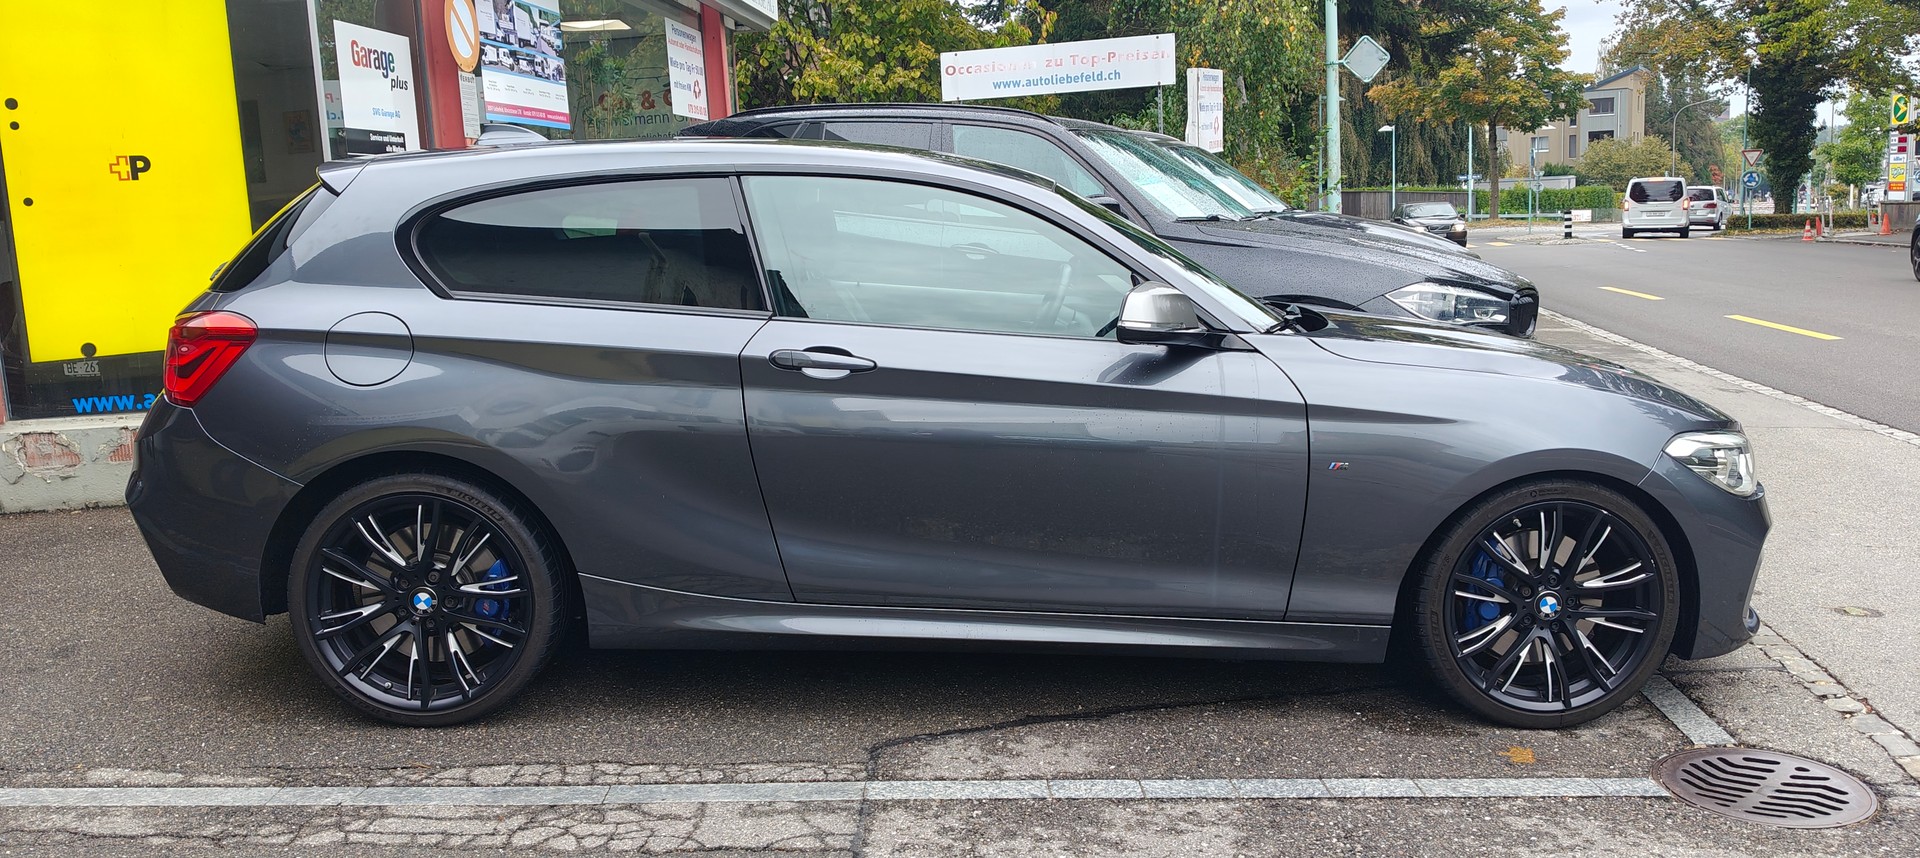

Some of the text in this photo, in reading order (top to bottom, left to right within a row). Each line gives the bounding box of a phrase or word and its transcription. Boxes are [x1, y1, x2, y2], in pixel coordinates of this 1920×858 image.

[350, 39, 395, 78] Garage
[1044, 57, 1063, 68] zu
[390, 75, 409, 91] plus
[992, 69, 1121, 89] www.autoliebefeld.ch
[381, 108, 394, 119] Garage
